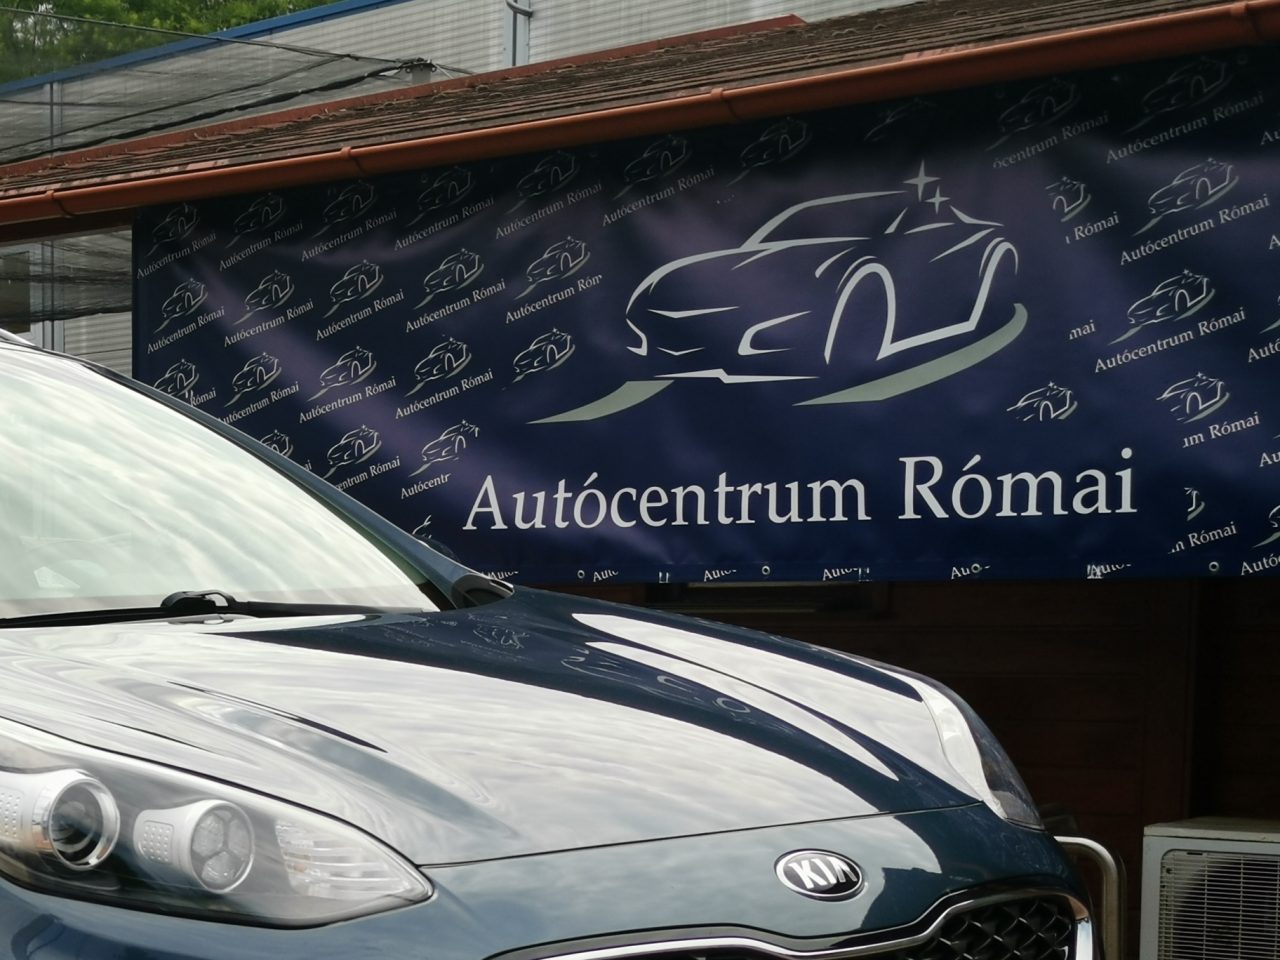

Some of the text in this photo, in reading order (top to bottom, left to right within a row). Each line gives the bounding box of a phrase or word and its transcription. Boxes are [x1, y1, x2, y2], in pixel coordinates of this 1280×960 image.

[1106, 115, 1209, 164] Autócentrum
[495, 182, 603, 238] Autócentrum Római
[602, 165, 715, 227] Autócentrum Római
[219, 221, 304, 271] Autócentrum Római
[301, 208, 398, 261] Autócentrum Római
[394, 196, 494, 251] Autócentrum Római
[1073, 212, 1120, 241] Római
[1120, 194, 1270, 266] Autócentrum Római
[136, 232, 217, 279] Autócentrum Római
[223, 299, 314, 347] Autócentrum Római
[316, 289, 405, 341] Autócentrum Római
[405, 278, 506, 333] Autócentrum Római
[505, 284, 576, 324] Autócentrum
[147, 307, 225, 354] Autócentrum Római
[1094, 306, 1246, 373] Autócentrum Római
[272, 381, 300, 404] Római
[299, 376, 397, 424] Autócentrum Római
[395, 367, 494, 419] Autócentrum Római
[1209, 411, 1261, 440] Római
[370, 455, 401, 479] Római
[462, 447, 1138, 531] Autócentrum Római
[1188, 521, 1237, 547] Római
[788, 856, 858, 889] KIA
